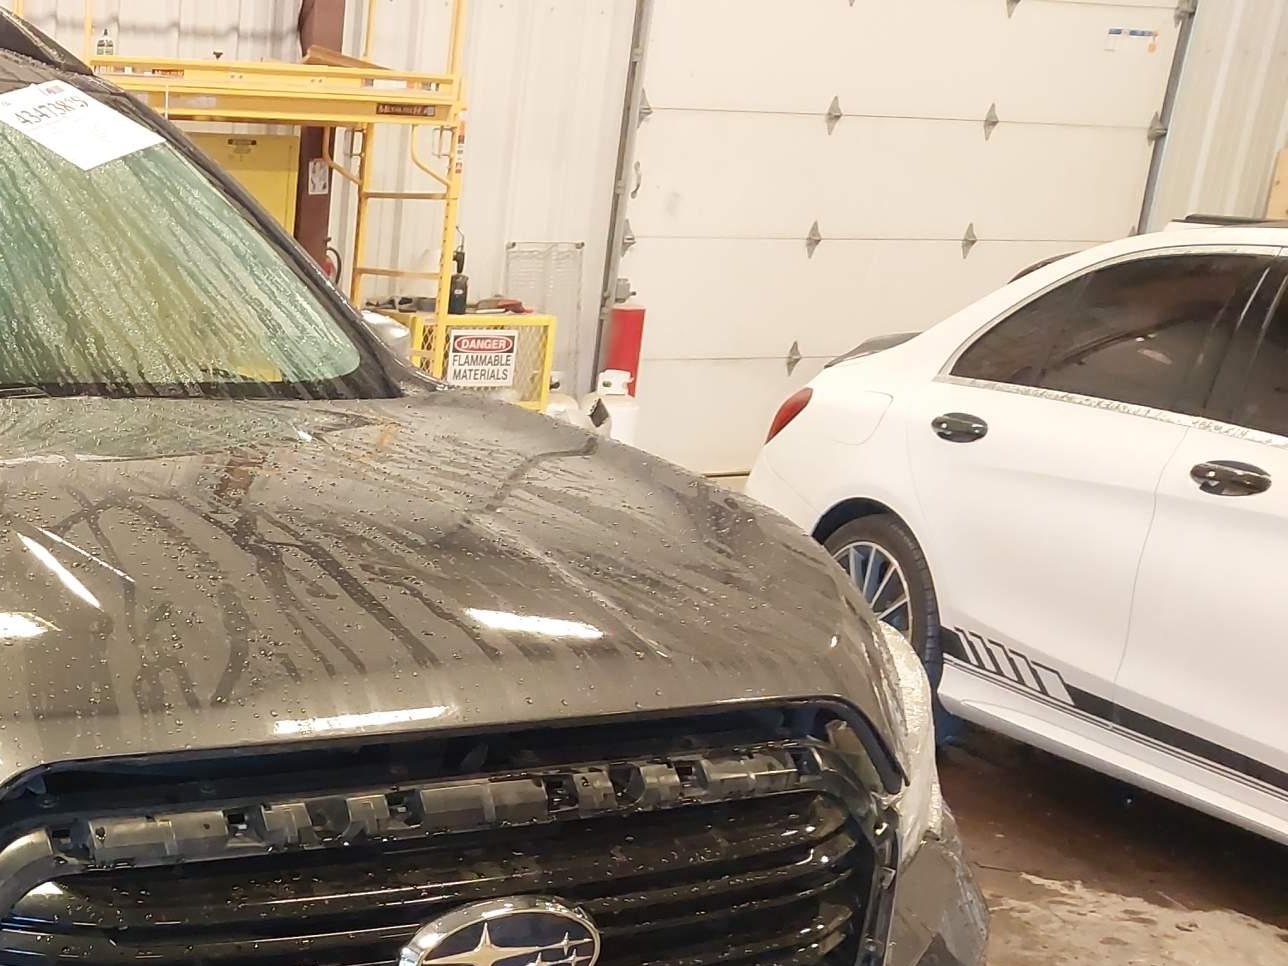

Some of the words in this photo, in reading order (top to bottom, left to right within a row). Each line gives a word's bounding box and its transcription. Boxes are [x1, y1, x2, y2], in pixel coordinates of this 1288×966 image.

[460, 338, 507, 350] DANGER
[452, 354, 512, 367] FLAMMABLE
[452, 368, 509, 381] MATERIALS
